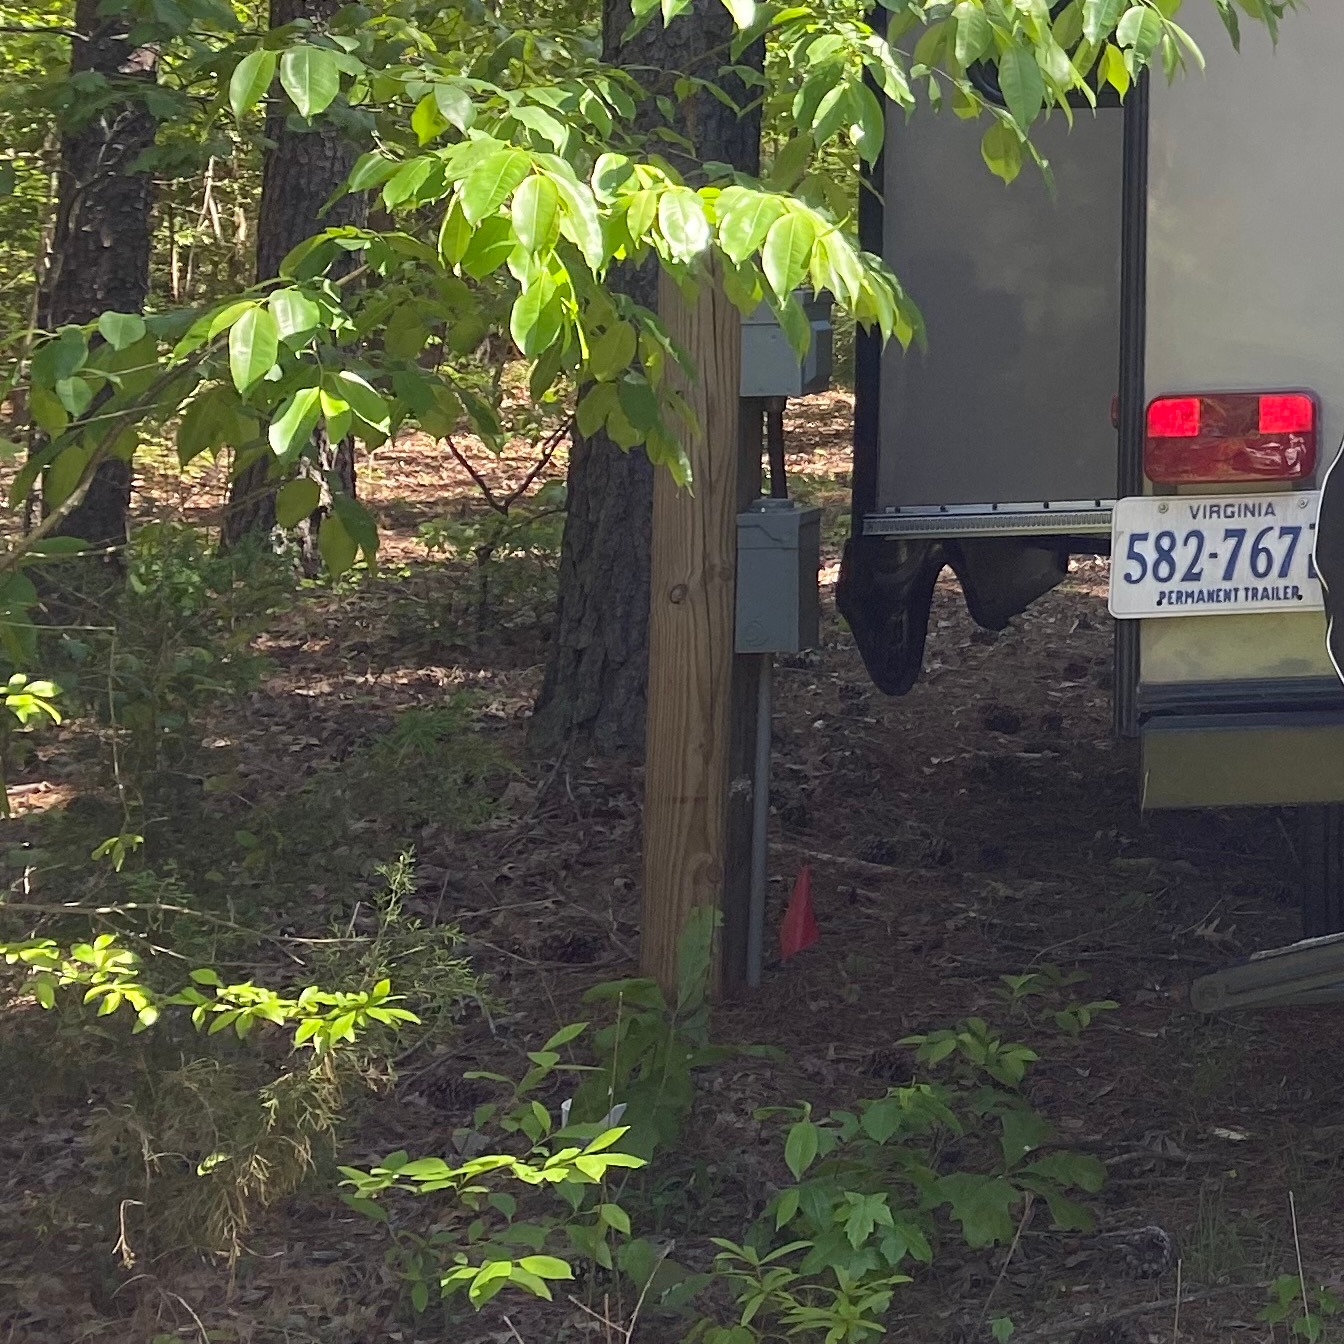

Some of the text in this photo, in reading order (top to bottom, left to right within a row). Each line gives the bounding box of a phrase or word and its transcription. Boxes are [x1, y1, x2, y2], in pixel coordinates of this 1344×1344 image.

[1189, 502, 1277, 520] VIRGINIA
[1158, 585, 1301, 605] PERMANENT TRAILER
